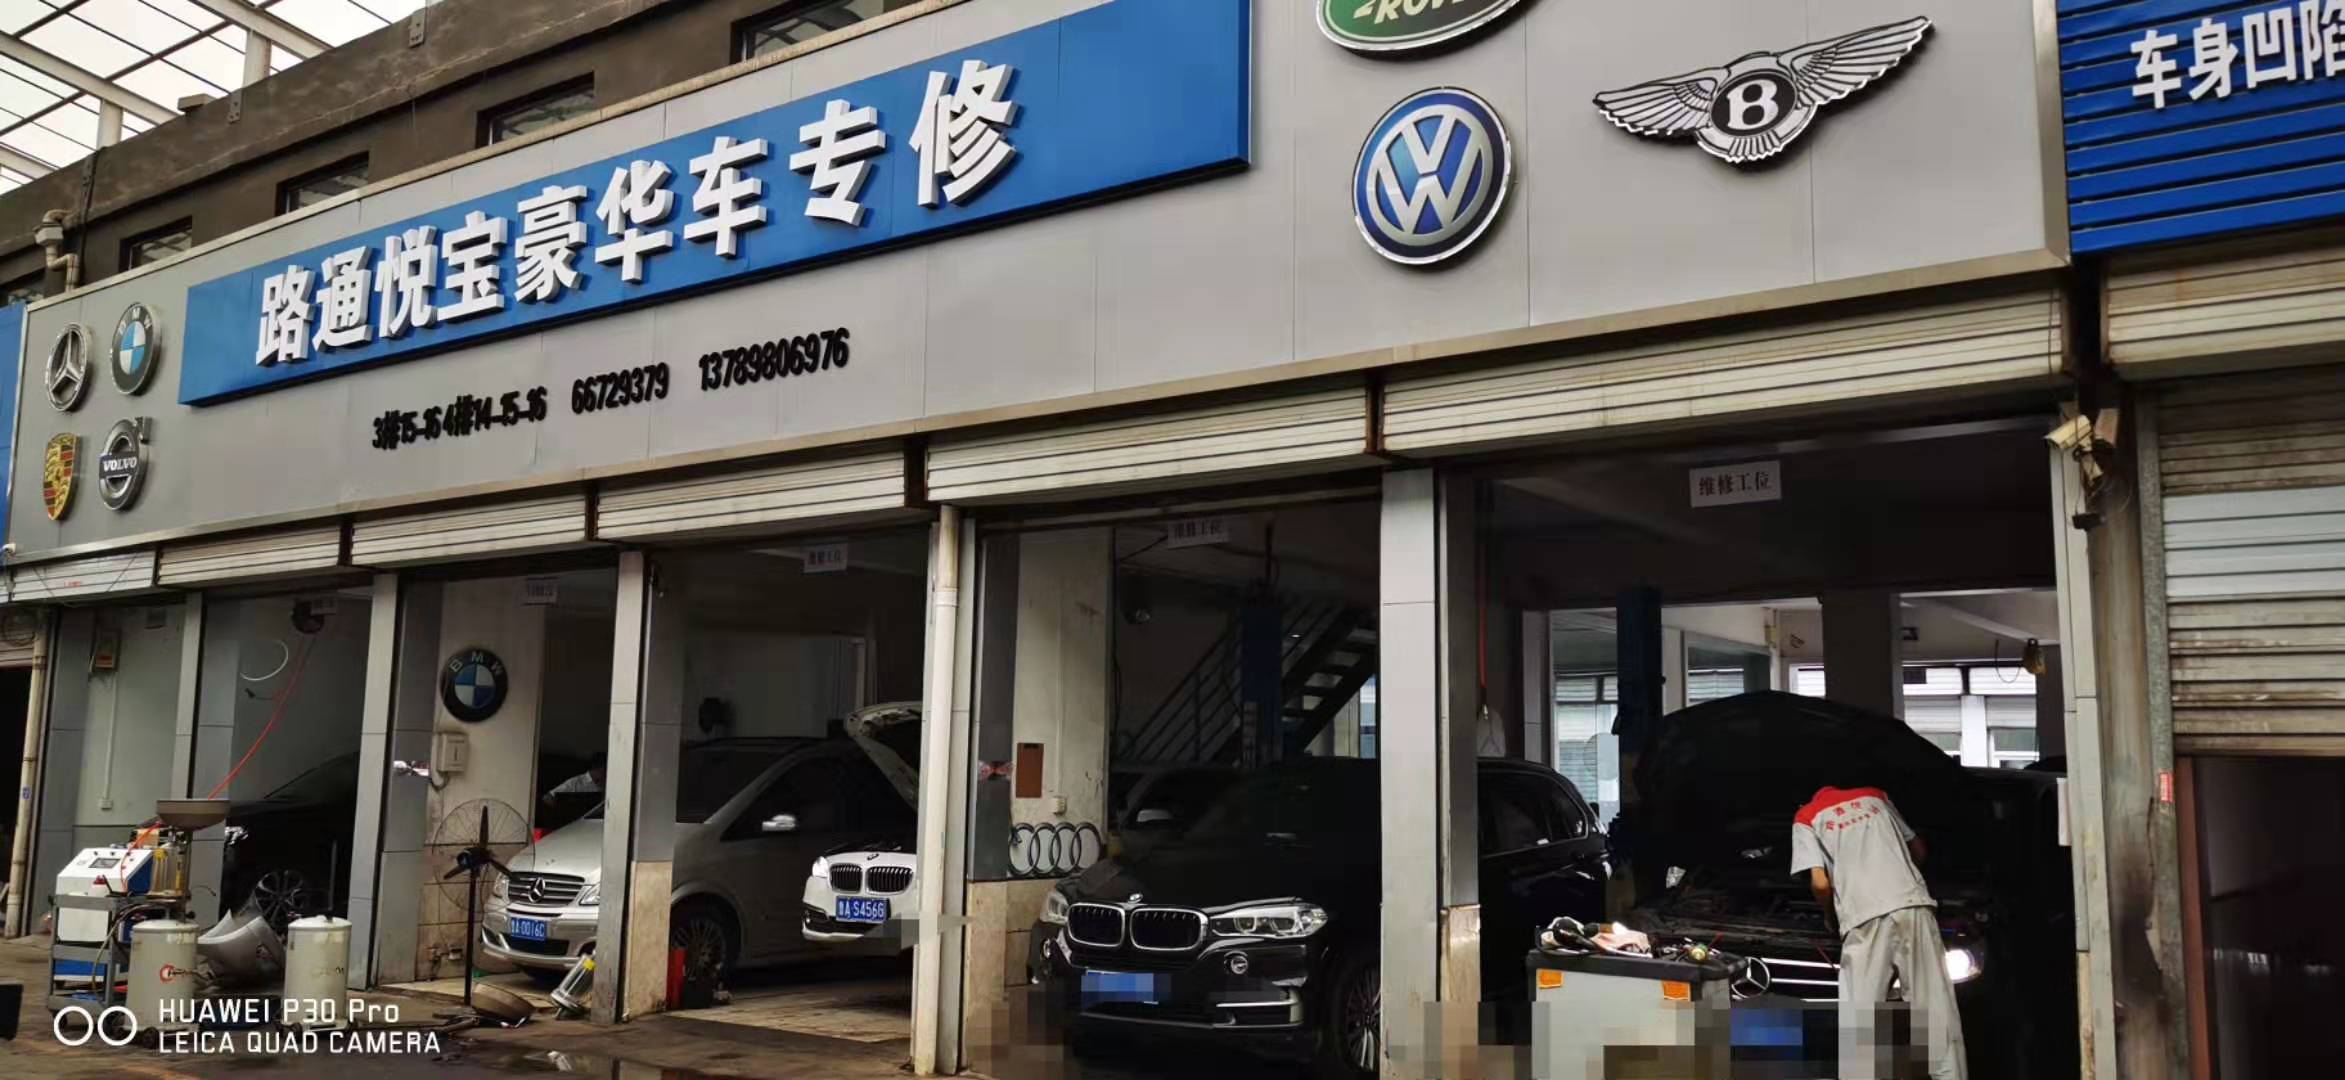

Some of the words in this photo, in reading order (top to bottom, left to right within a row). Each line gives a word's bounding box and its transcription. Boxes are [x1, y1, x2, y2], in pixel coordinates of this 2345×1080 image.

[2130, 0, 2345, 109] 车身凹陷
[256, 60, 1018, 366] 路通悦宝豪华车专修
[571, 362, 670, 414] 66729379
[699, 327, 850, 391] 13789806976
[102, 456, 138, 472] VOLVO
